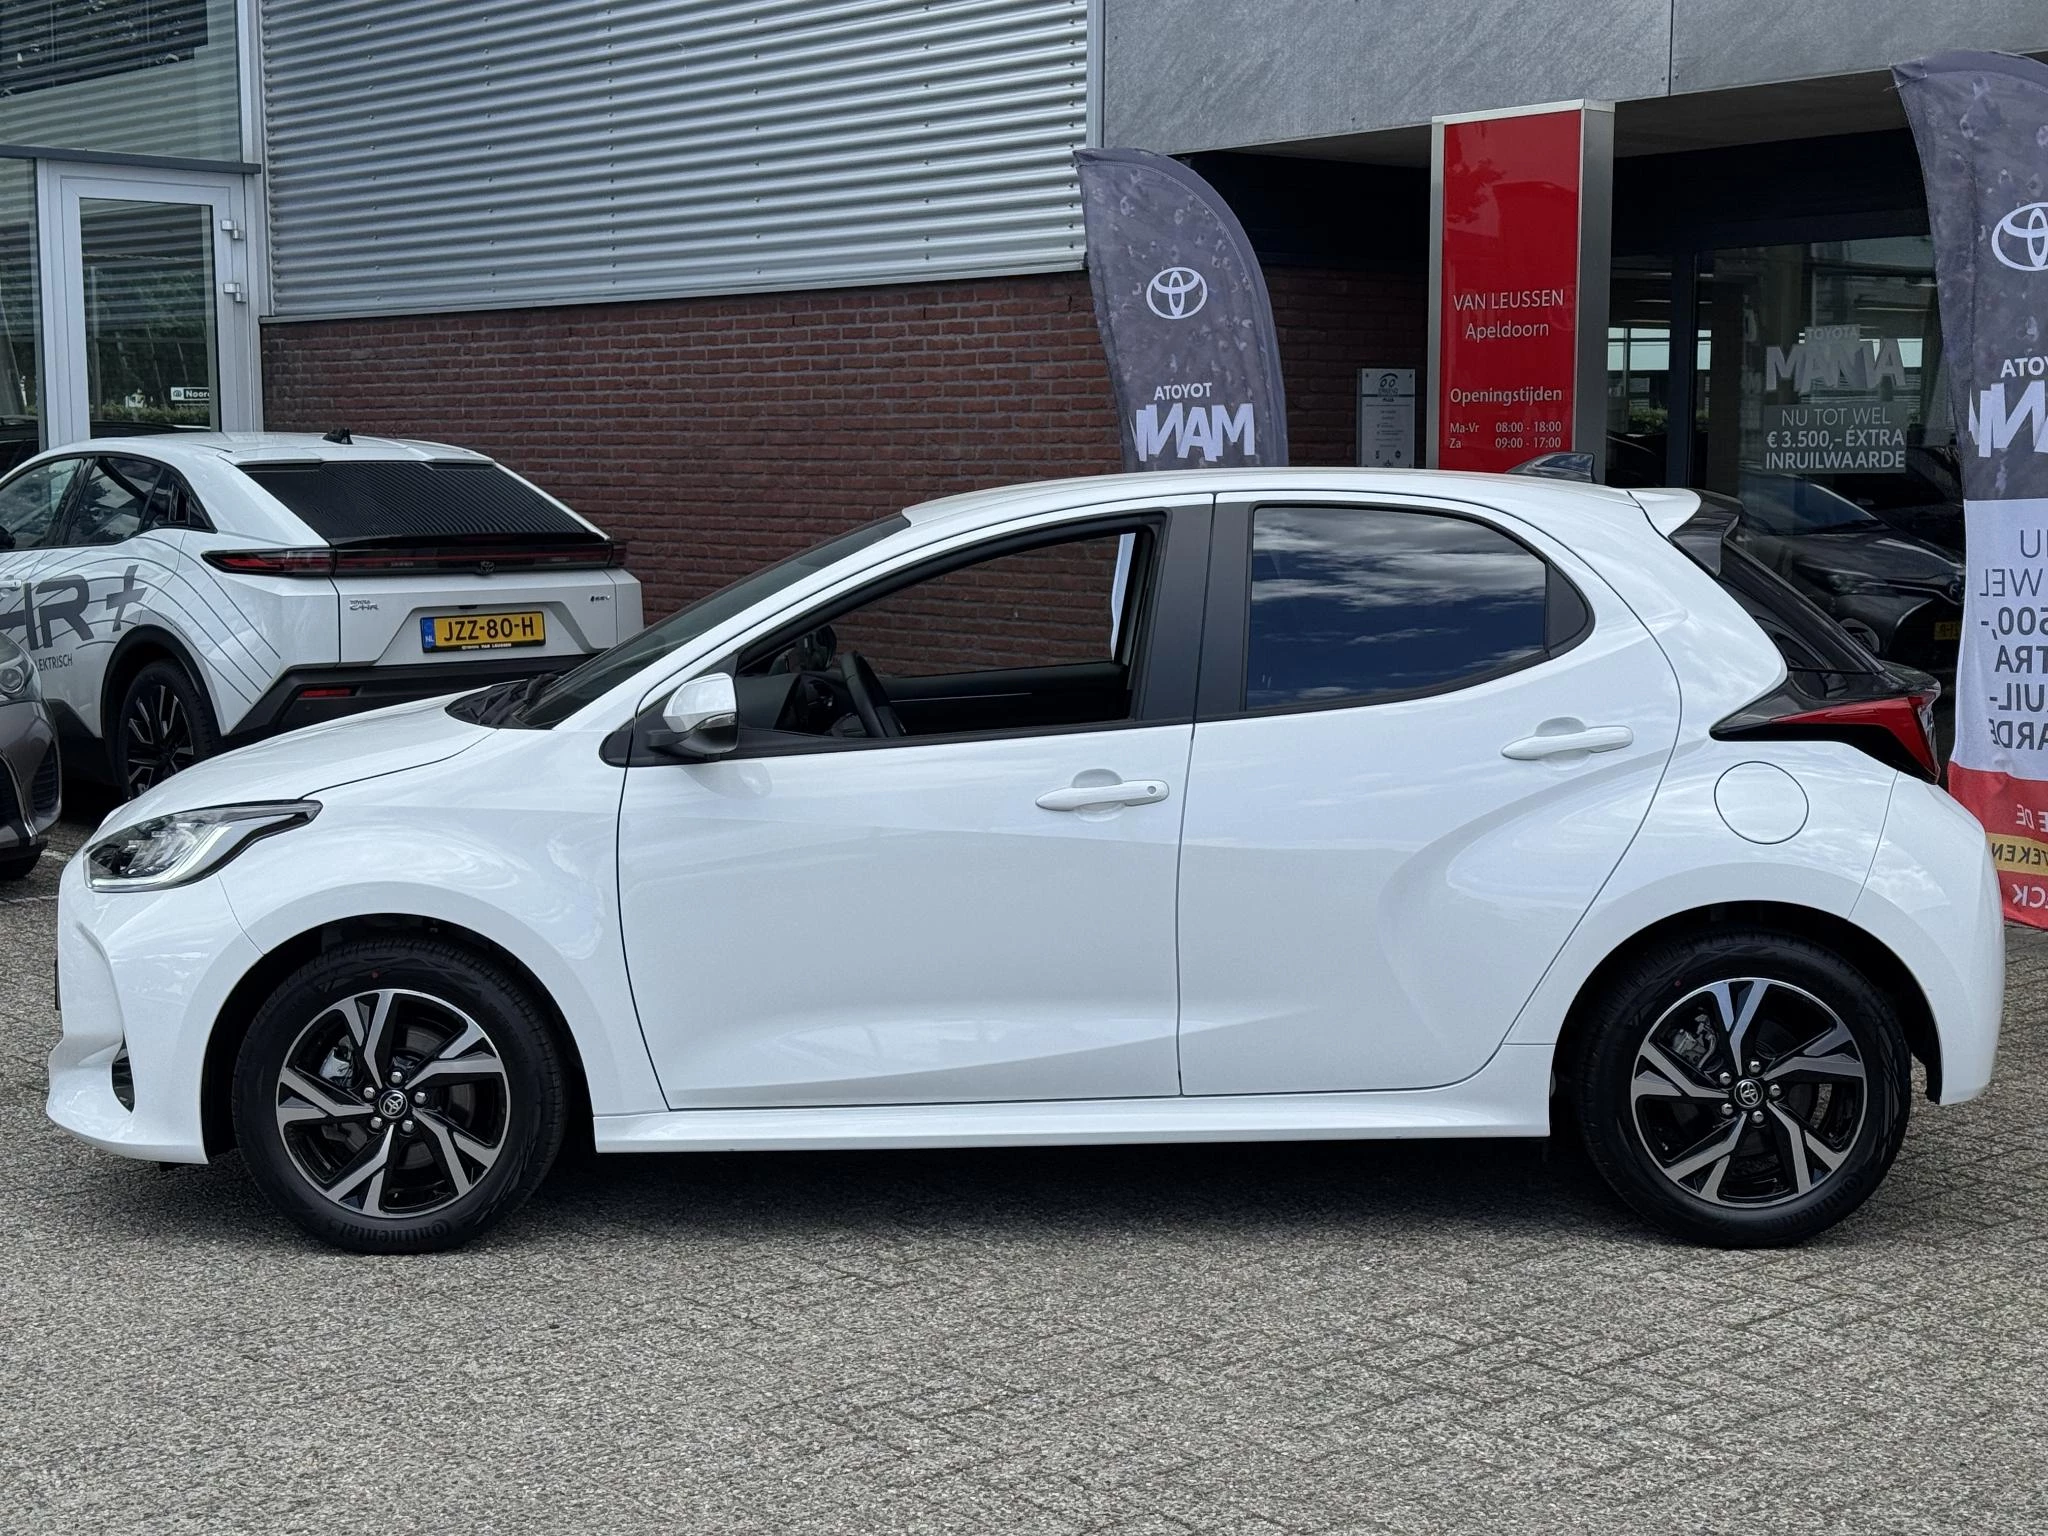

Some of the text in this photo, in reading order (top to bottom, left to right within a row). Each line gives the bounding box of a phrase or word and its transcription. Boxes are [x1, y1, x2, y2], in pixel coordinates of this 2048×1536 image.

[1453, 288, 1564, 311] VAN LEUSSEN
[1465, 320, 1549, 343] Apeldoorn
[1805, 327, 1860, 340] TOYOTA
[1766, 338, 1906, 395] MANIA
[1450, 386, 1562, 407] Openingstijden
[1782, 407, 1891, 426] NU TOT WEL
[1450, 422, 1480, 433] Ma-Vr
[1495, 422, 1524, 433] 08:00
[1534, 421, 1562, 433] 18:00
[1449, 438, 1462, 449] Za
[1495, 437, 1523, 449] 09:00
[1534, 437, 1561, 448] 17:00
[1766, 425, 1905, 450] € 3.500,- ÉXTRA
[1766, 451, 1905, 469] INRUILWAARDE
[425, 635, 434, 643] NL
[444, 616, 535, 642] JZZ-80-H
